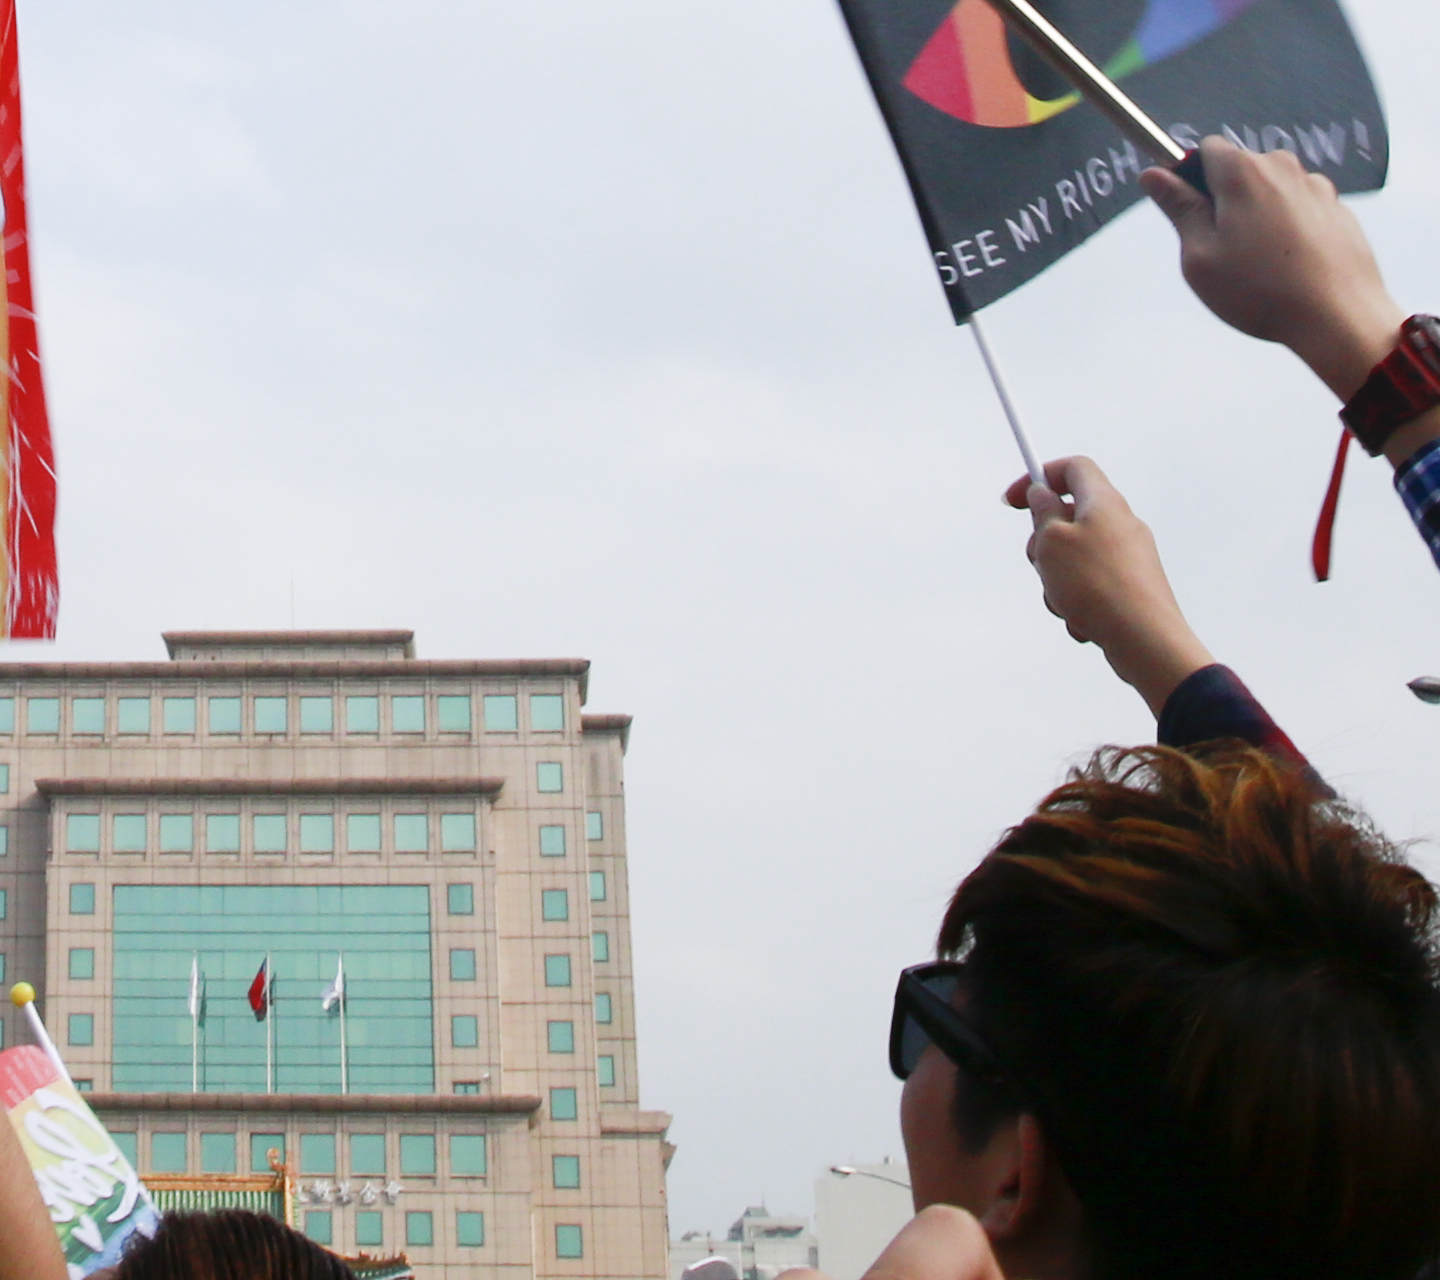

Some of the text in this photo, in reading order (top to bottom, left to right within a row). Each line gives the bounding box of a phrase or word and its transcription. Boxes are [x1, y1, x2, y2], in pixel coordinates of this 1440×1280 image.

[934, 228, 1006, 286] SEE
[1005, 197, 1053, 252] MY
[1055, 122, 1200, 218] RIGHS
